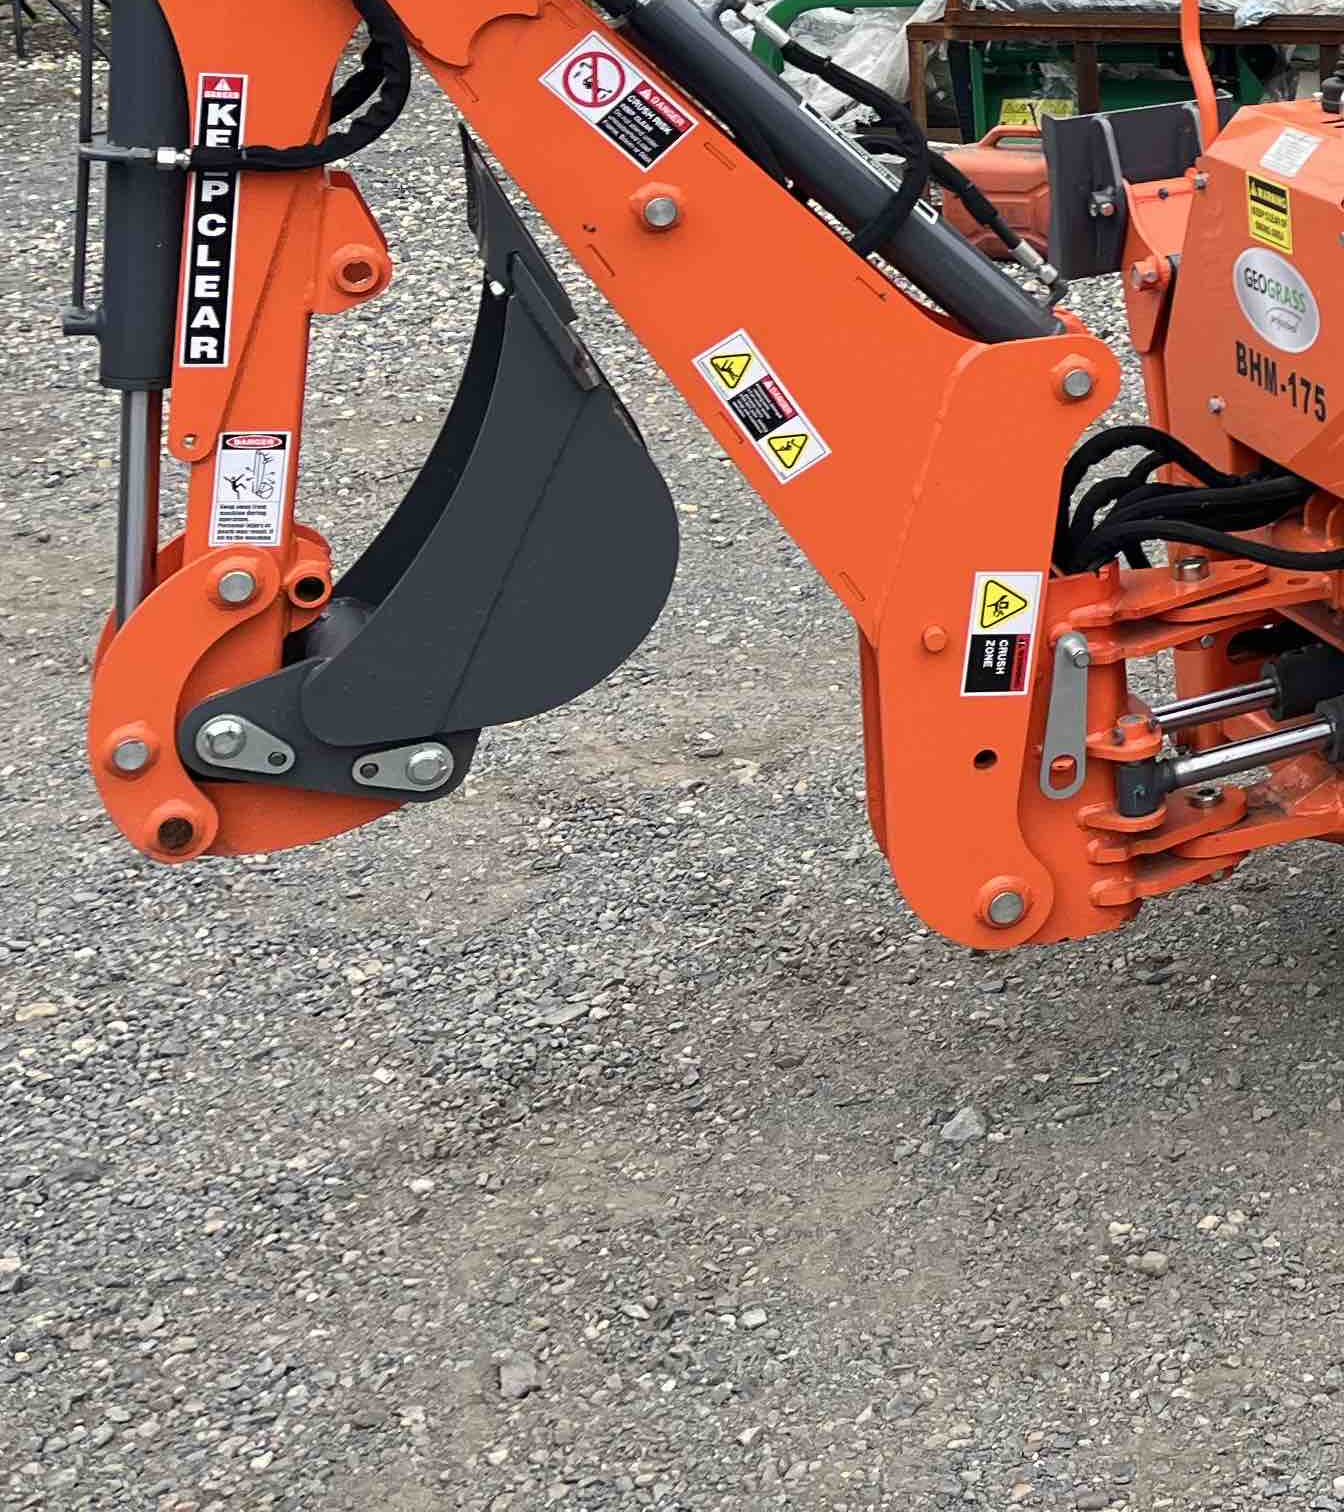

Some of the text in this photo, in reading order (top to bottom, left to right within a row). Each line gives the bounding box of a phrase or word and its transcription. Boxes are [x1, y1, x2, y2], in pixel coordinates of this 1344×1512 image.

[190, 102, 238, 359] KEP CLEAR
[1243, 267, 1307, 313] GEOGRASS
[1235, 340, 1328, 423] BHM-175
[983, 639, 996, 668] ZONE
[995, 639, 1009, 675] CRUSH
